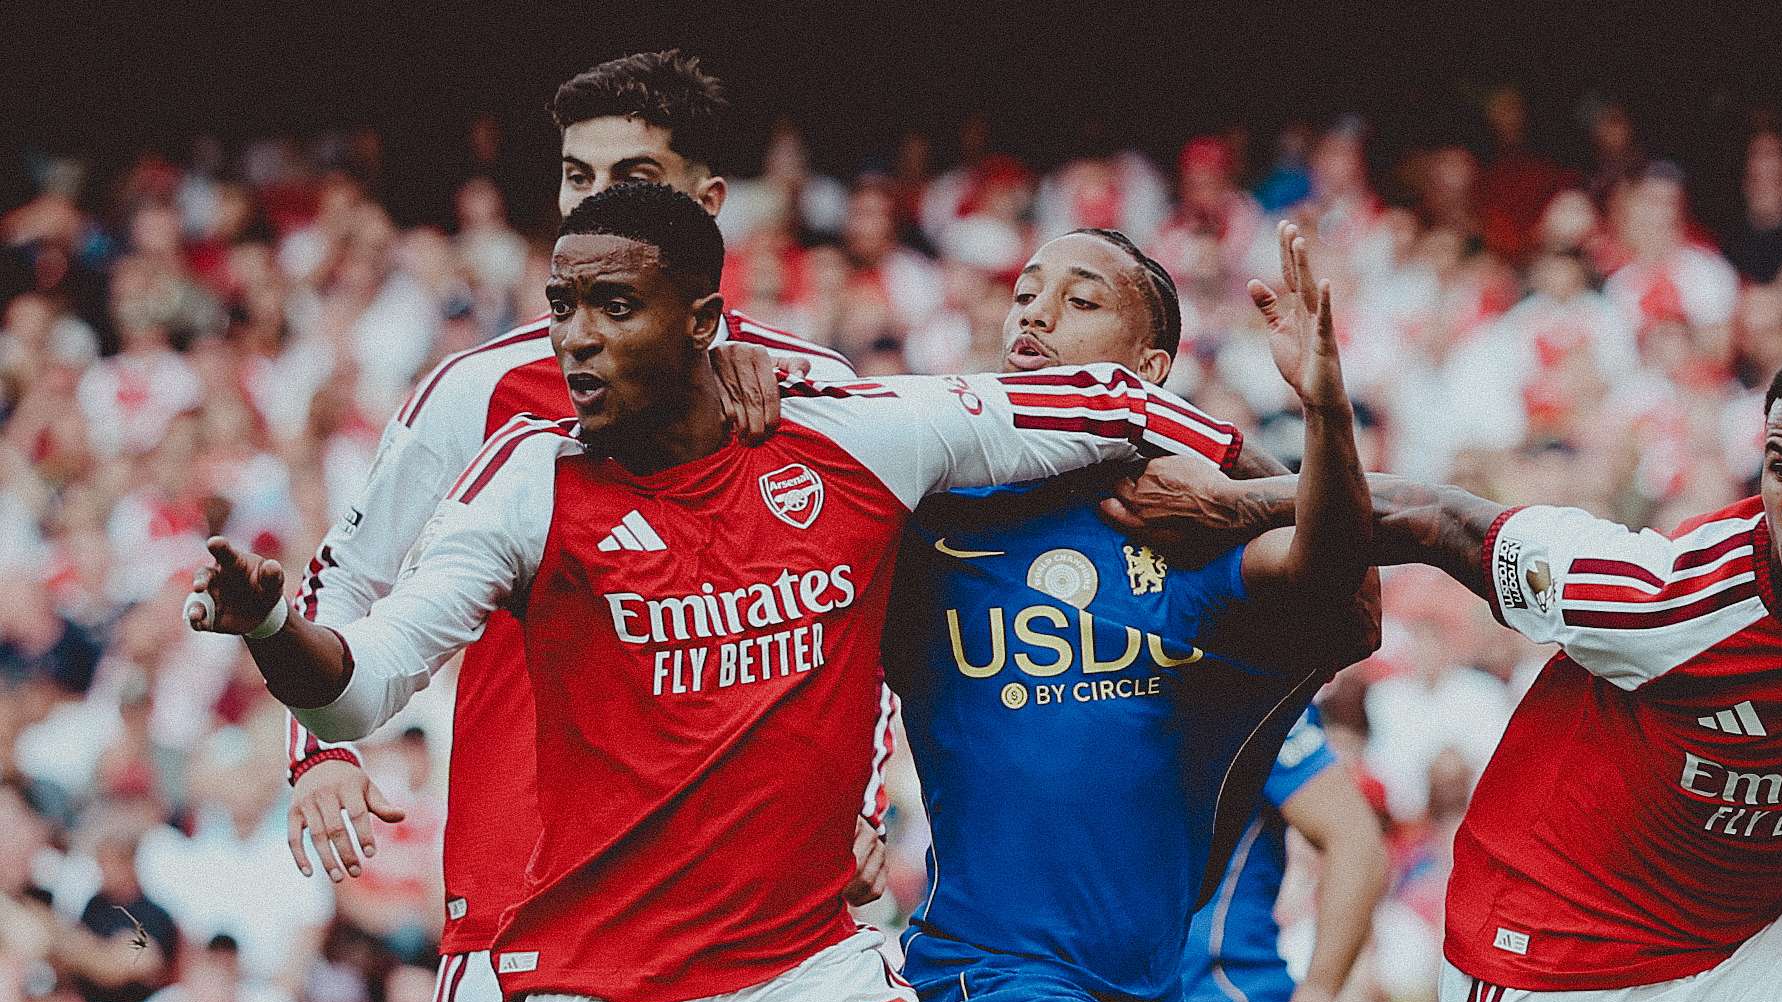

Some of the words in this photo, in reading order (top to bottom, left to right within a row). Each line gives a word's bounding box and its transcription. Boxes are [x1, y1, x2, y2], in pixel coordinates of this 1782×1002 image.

[769, 470, 813, 491] Arsenal
[604, 564, 855, 644] Emirates
[653, 647, 708, 696] FLY
[719, 622, 825, 688] BETTER
[1036, 684, 1065, 705] BY
[1072, 676, 1161, 702] CIRCLE
[1704, 806, 1770, 837] FLY
